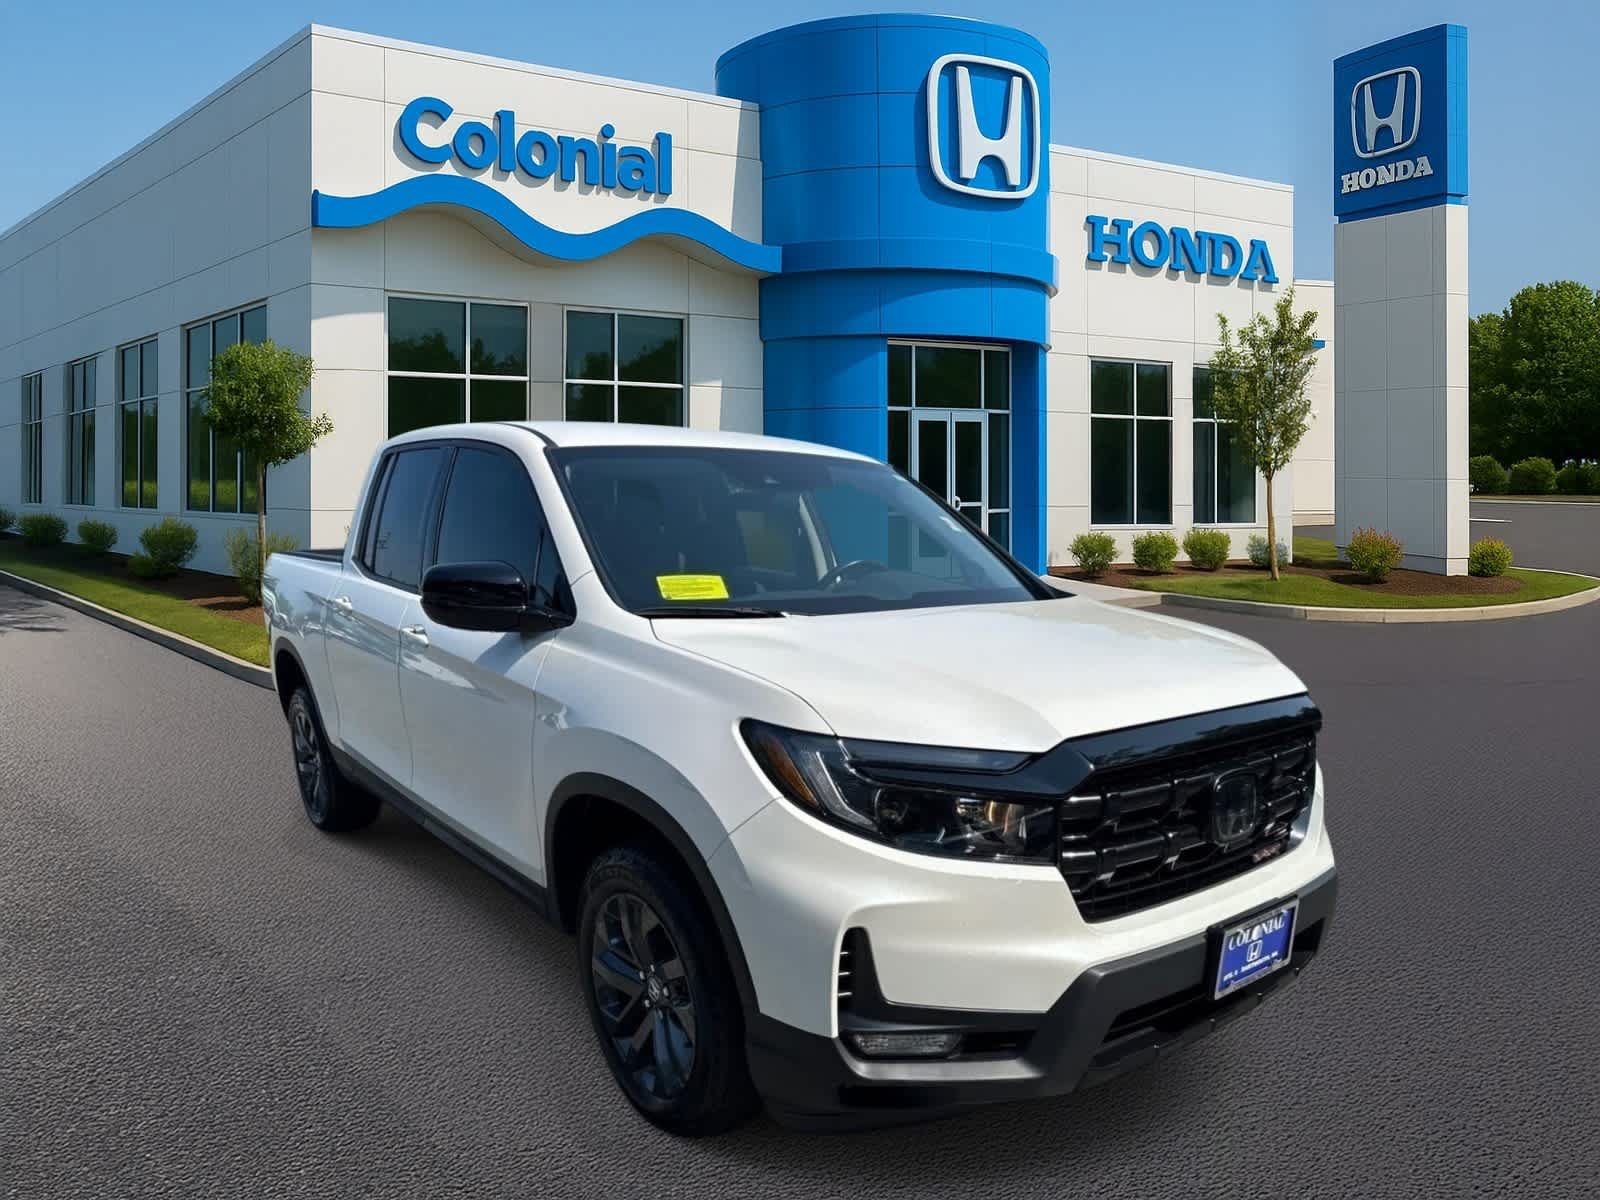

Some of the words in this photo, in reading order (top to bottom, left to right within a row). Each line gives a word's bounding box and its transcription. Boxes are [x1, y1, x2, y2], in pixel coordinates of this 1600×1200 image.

[400, 96, 672, 195] Colonial
[1341, 156, 1434, 194] HONDA
[1086, 215, 1280, 284] HONDA
